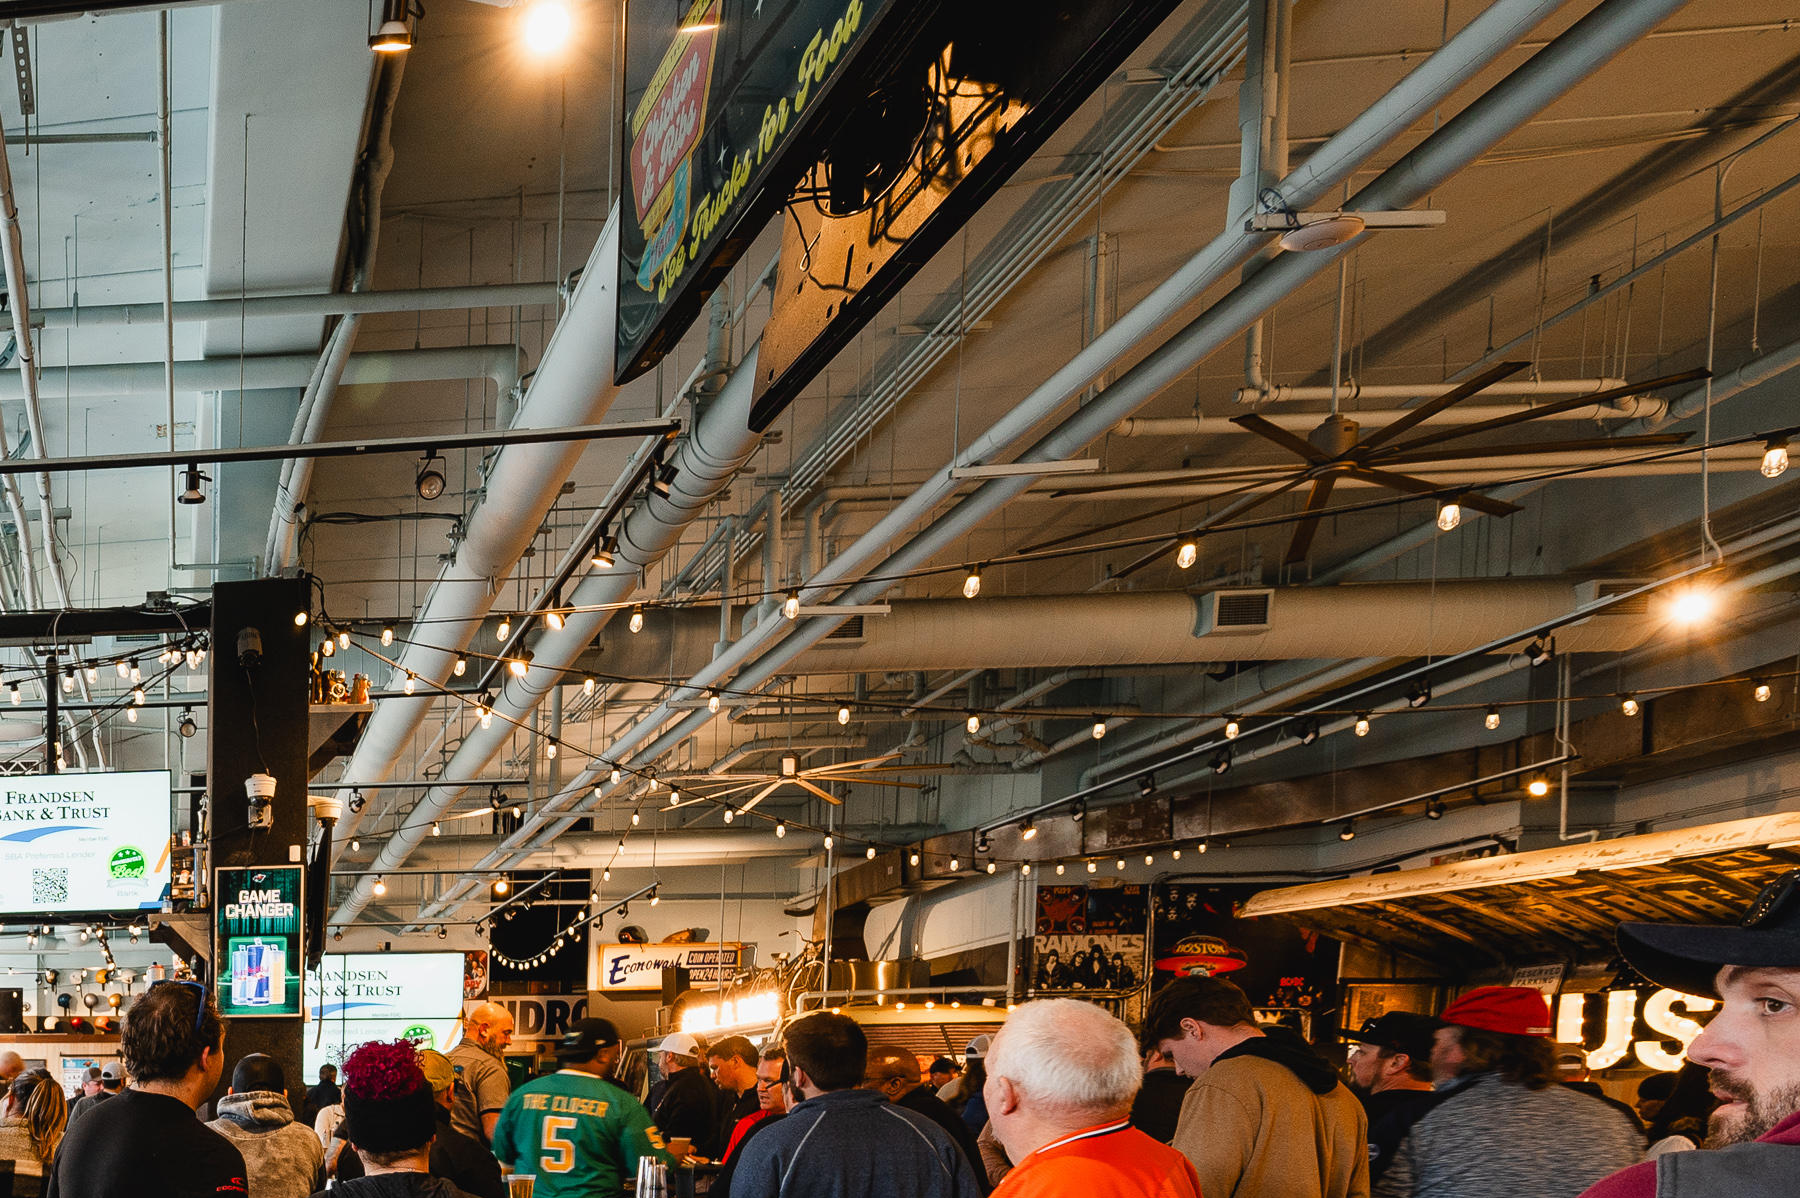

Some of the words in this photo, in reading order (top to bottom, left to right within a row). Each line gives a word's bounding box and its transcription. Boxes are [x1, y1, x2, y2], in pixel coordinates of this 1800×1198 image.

[641, 50, 700, 167] Chicken
[641, 161, 654, 209] &
[658, 100, 696, 184] Ribs
[658, 244, 686, 303] See
[689, 149, 753, 261] Trucks
[757, 97, 790, 166] for
[795, 0, 863, 113] Food
[5, 791, 95, 805] FRANDSEN
[40, 807, 53, 820] &
[57, 806, 111, 820] TRUST
[67, 850, 96, 859] Lender
[112, 865, 144, 878] Best
[117, 888, 138, 897] Bank
[239, 889, 281, 904] GAME
[225, 903, 294, 919] CHANGER
[1034, 934, 1144, 954] RAMONES
[1176, 943, 1226, 955] BOSTON
[689, 952, 703, 964] COIN
[304, 970, 388, 982] FRANDSEN
[608, 953, 683, 985] Econowash
[704, 968, 713, 980] 24
[1516, 967, 1561, 978] RESERVED
[1516, 977, 1553, 986] PARKING
[334, 985, 349, 997] &
[352, 984, 403, 997] TRUST
[523, 1094, 551, 1110] THE
[552, 1096, 609, 1118] CLOSER
[540, 1115, 578, 1174] 5
[644, 1126, 666, 1149] 5
